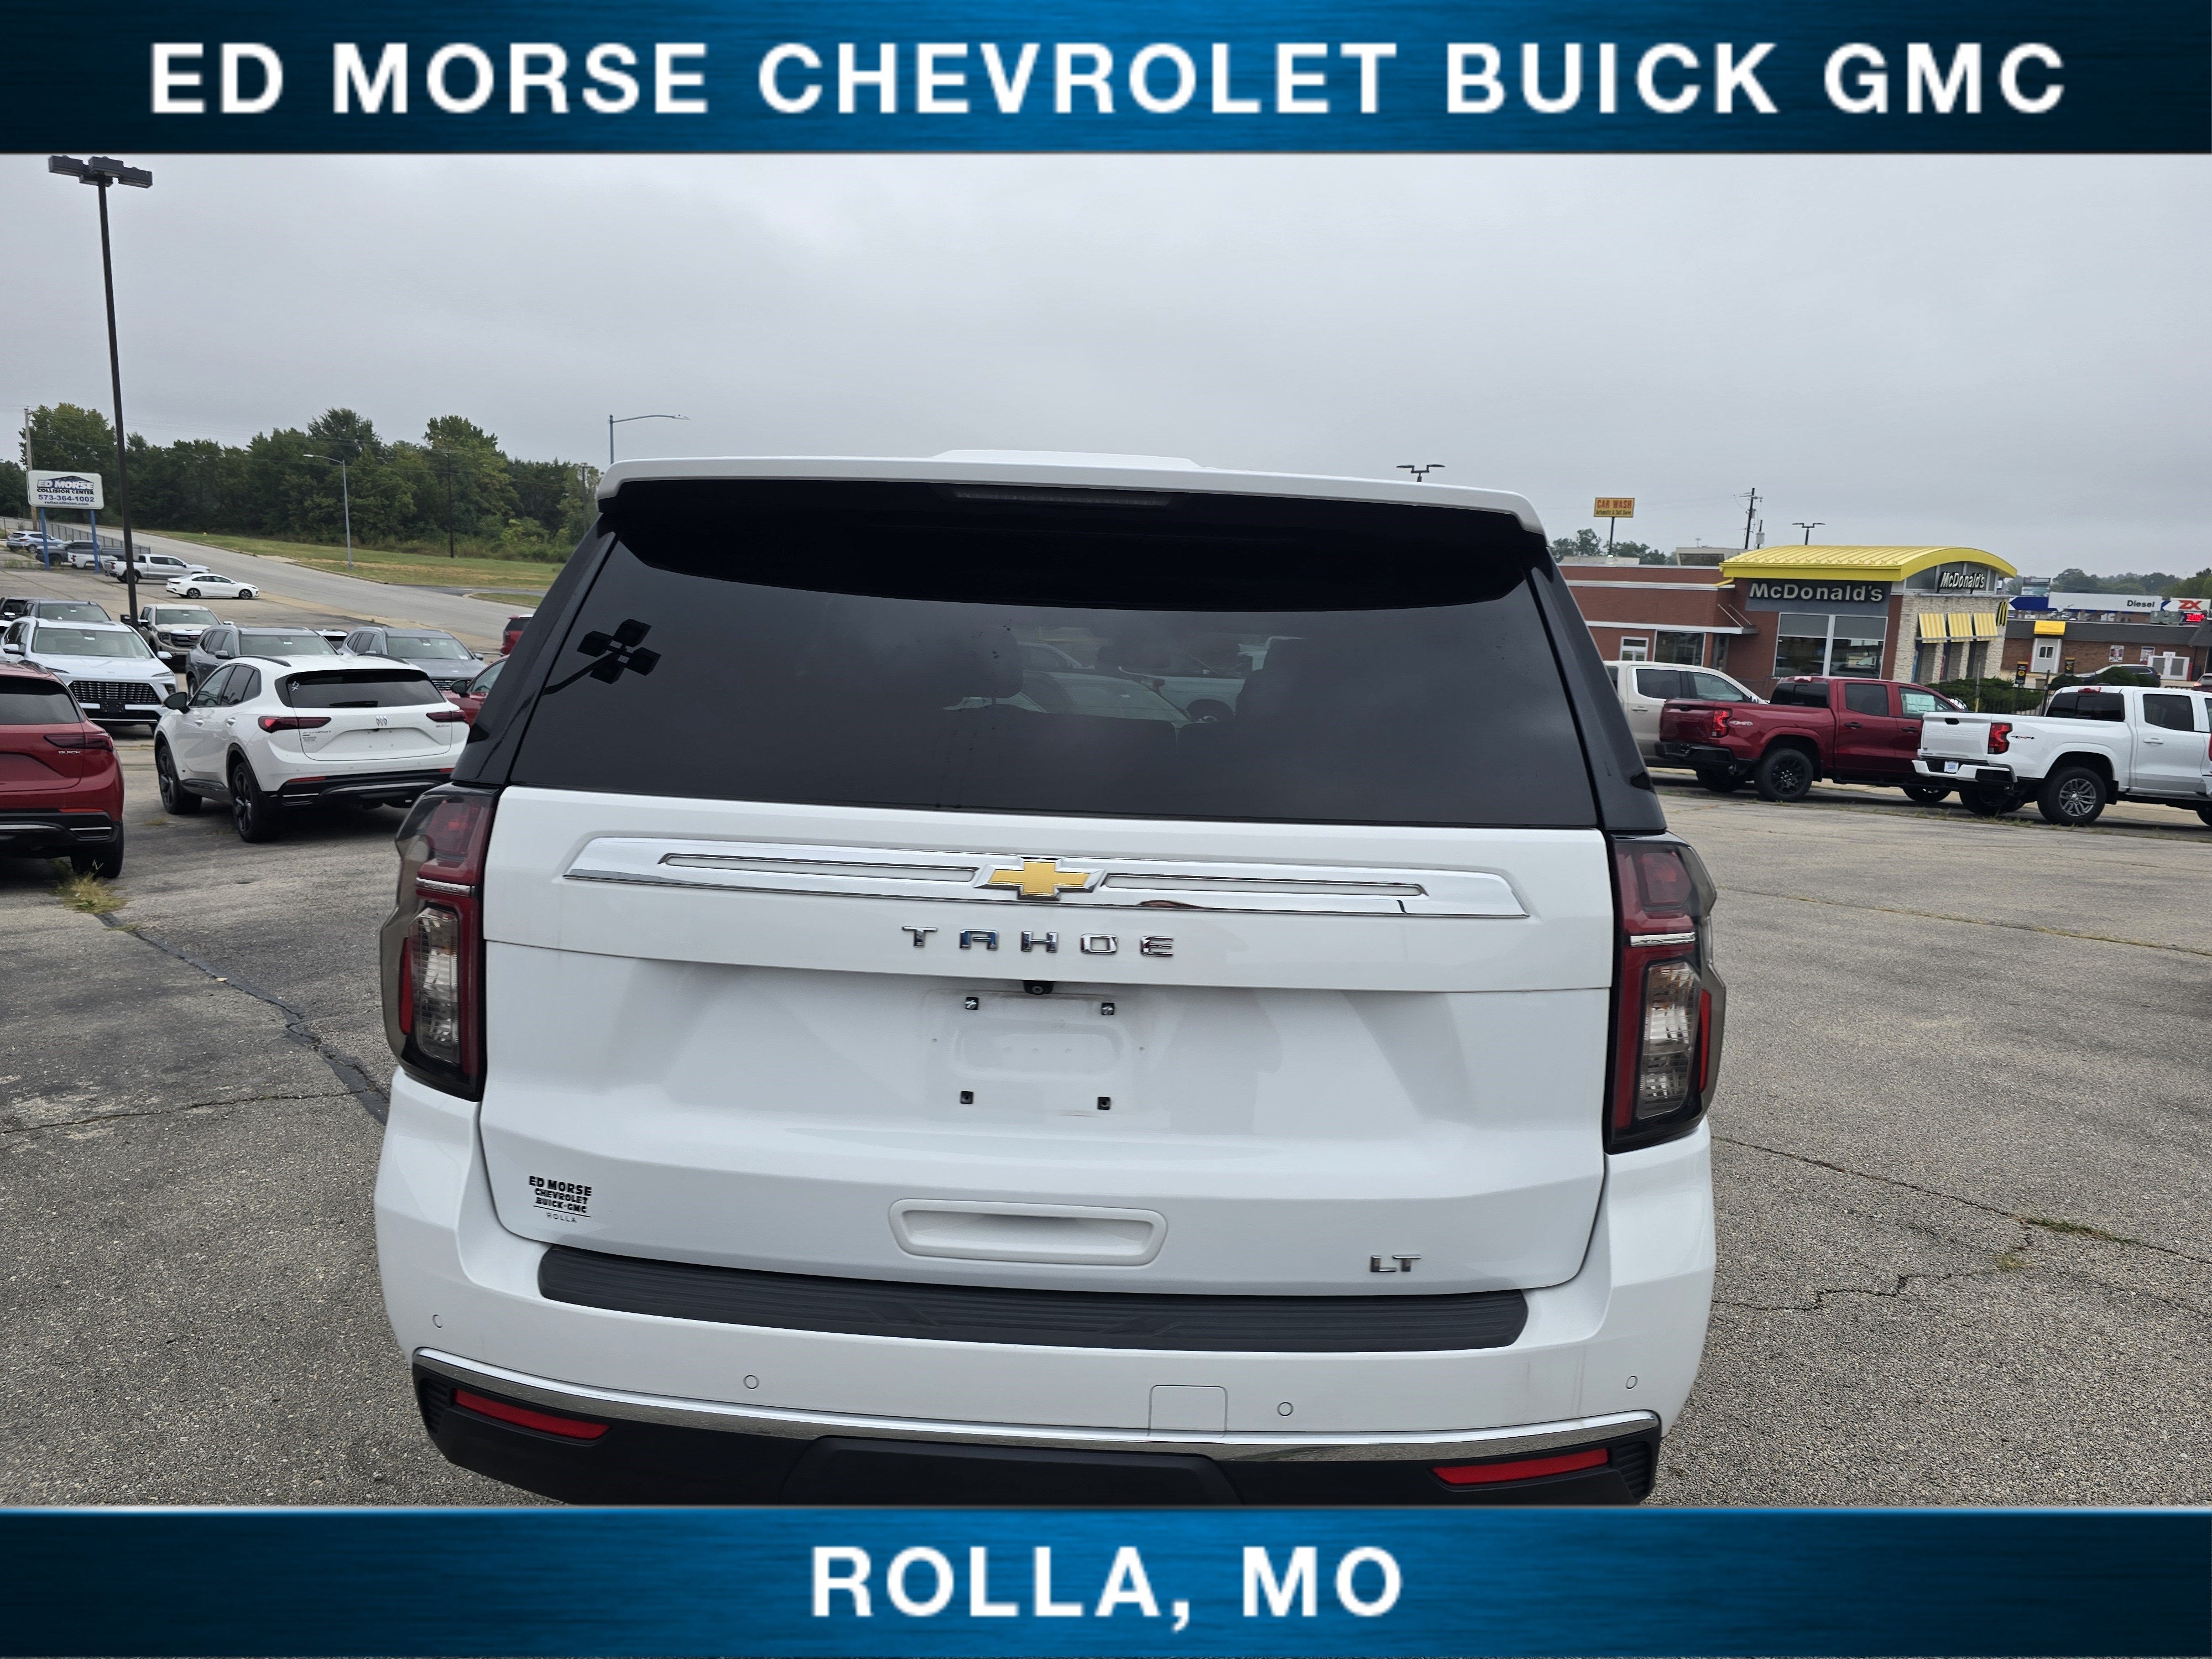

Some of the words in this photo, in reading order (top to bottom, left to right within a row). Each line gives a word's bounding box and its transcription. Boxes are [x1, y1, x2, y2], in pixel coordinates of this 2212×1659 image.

[37, 479, 53, 488] ED
[54, 480, 93, 490] MORSE
[1597, 500, 1610, 508] CAR
[1613, 500, 1632, 509] WASH
[1939, 571, 1986, 588] McDonald's
[1749, 582, 1883, 602] McDonald's
[2178, 599, 2203, 611] ZX
[901, 926, 1175, 957] TAHOE
[529, 1175, 544, 1187] ED
[547, 1179, 592, 1196] MORSE
[535, 1188, 588, 1204] CHEVROLET
[546, 1212, 577, 1223] ROLLA
[1370, 1254, 1422, 1272] LT
